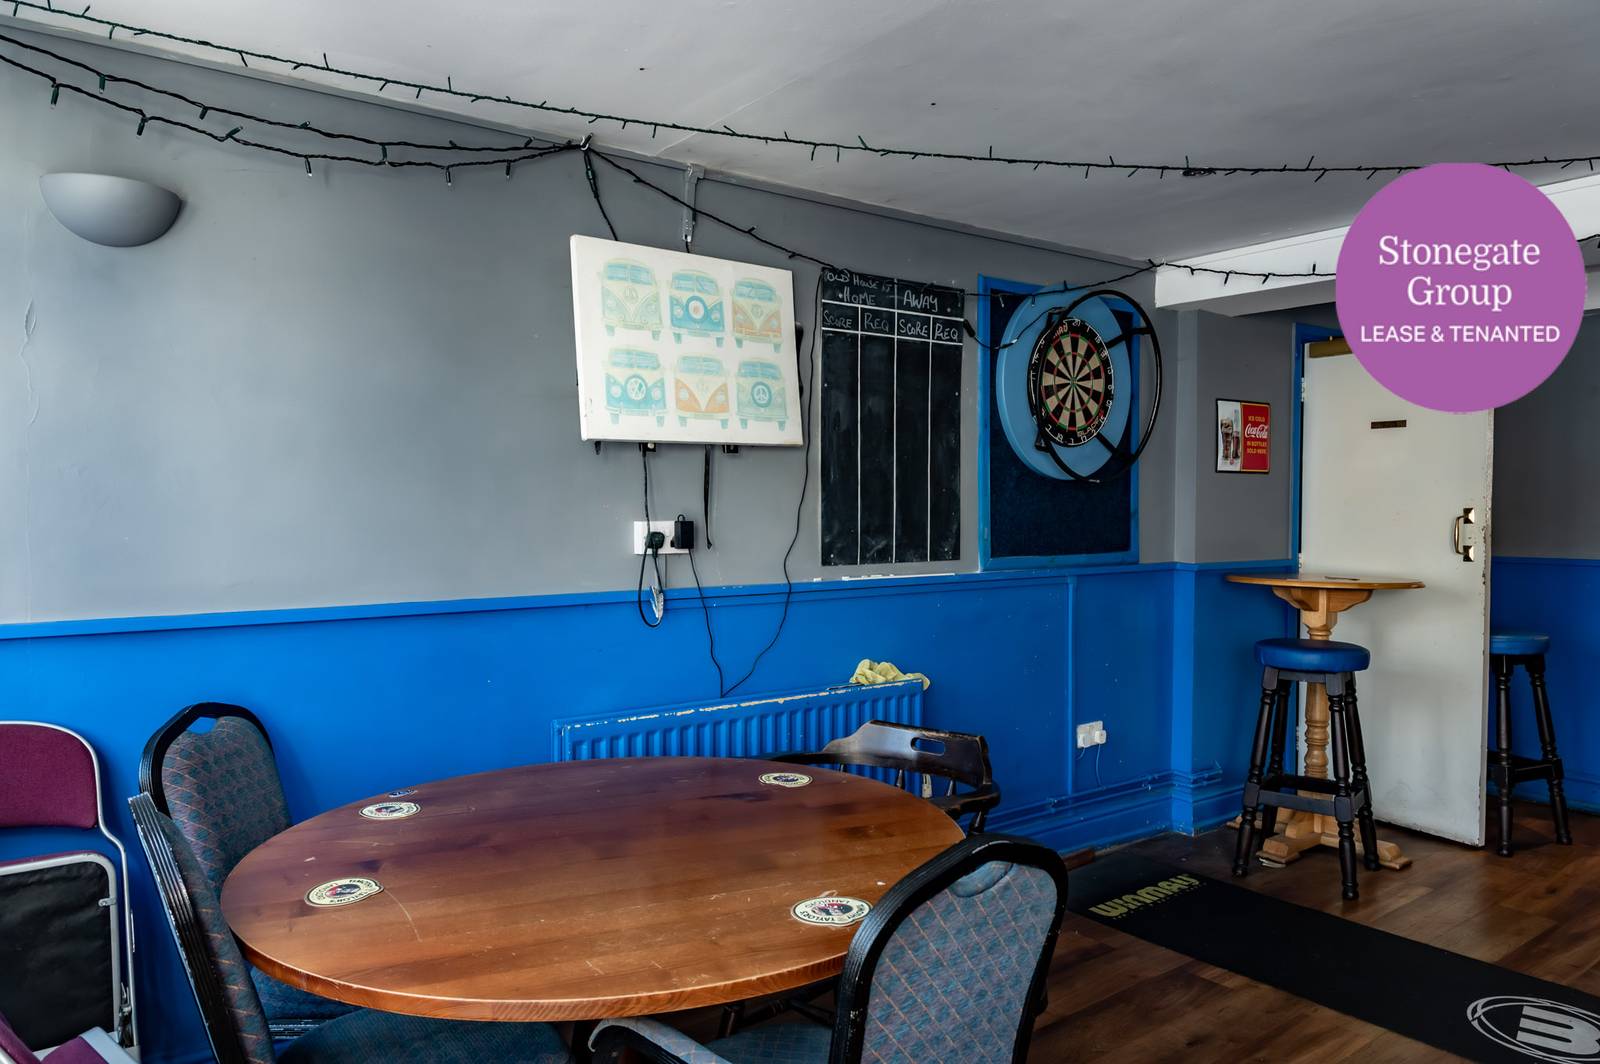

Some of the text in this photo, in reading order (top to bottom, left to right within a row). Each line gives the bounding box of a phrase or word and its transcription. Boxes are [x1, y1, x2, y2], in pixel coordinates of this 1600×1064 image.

[903, 290, 938, 312] AWAY
[864, 312, 889, 332] REQ
[899, 319, 928, 337] SCORE
[934, 323, 959, 341] REQ
